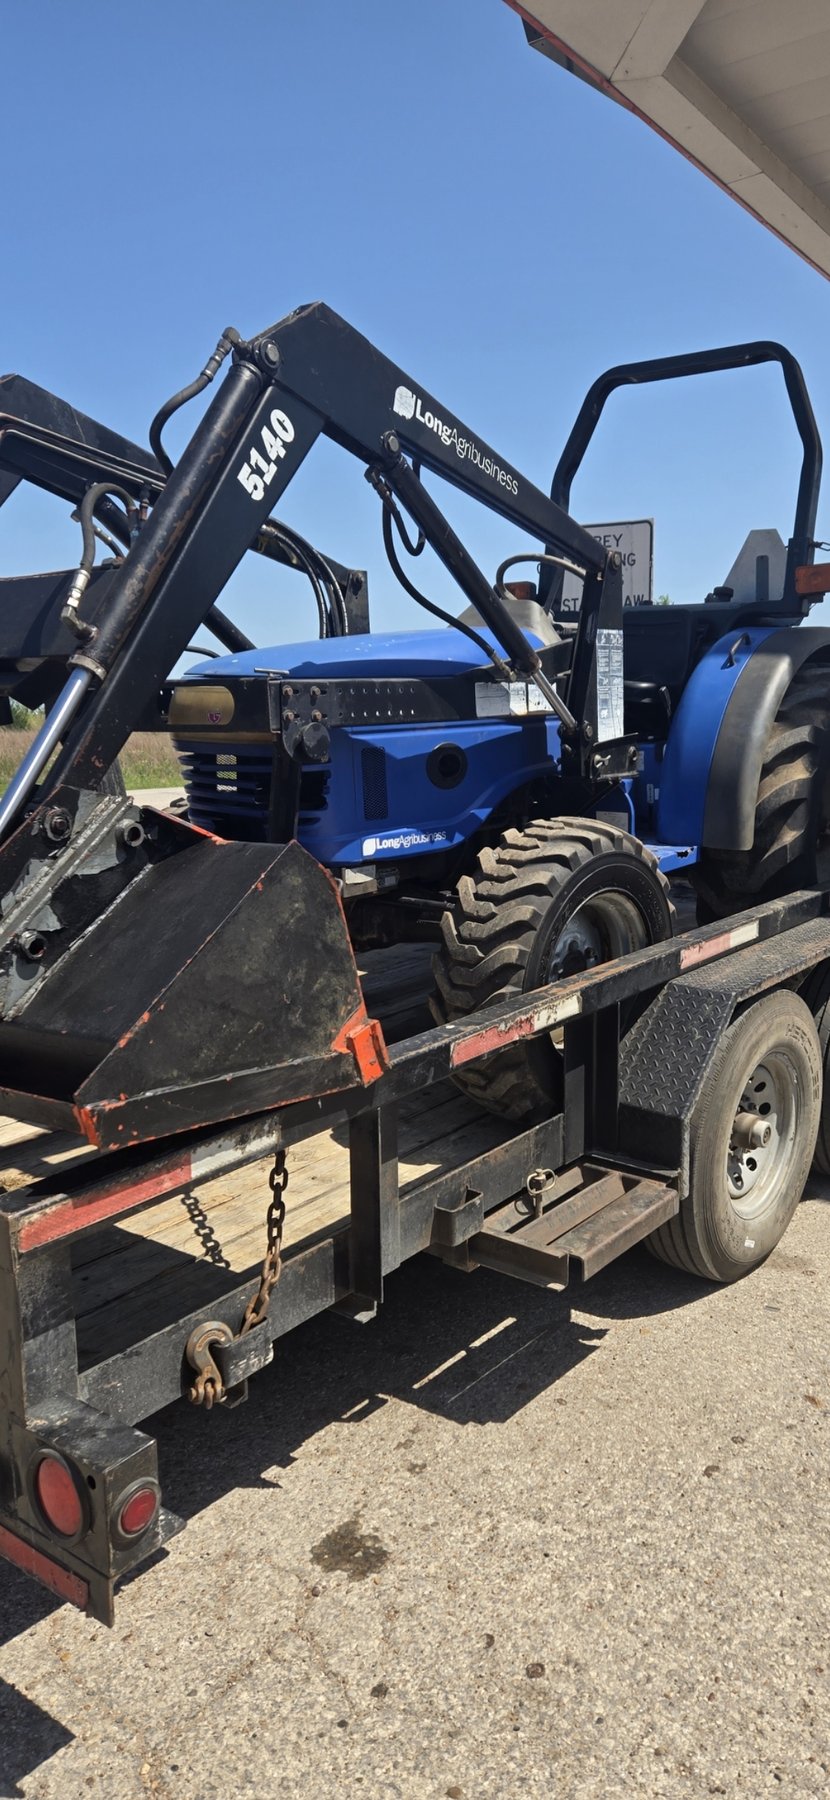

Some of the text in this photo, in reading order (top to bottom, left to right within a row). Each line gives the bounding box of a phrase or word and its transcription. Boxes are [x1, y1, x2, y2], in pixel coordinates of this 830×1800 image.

[237, 408, 295, 501] 5140
[415, 398, 519, 496] LongAgribusiness
[376, 830, 447, 849] LongAgribusiness
